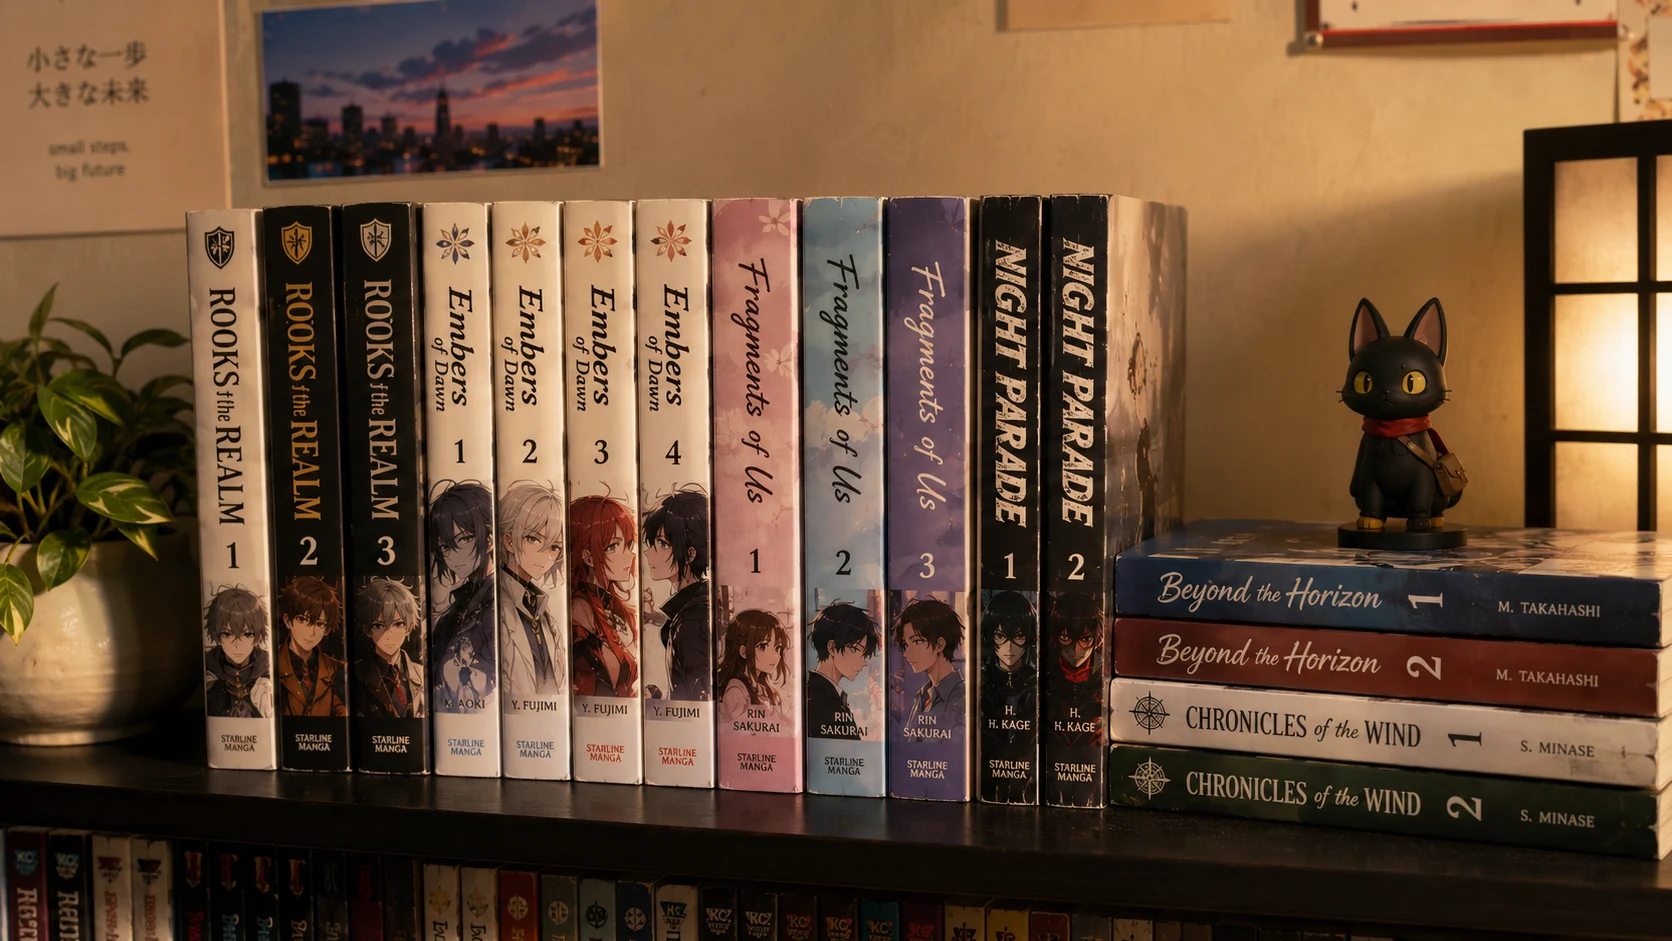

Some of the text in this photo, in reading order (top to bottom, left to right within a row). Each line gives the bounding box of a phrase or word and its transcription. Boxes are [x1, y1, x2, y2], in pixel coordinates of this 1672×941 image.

[26, 40, 148, 73] 小さな一歩
[28, 77, 150, 109] 大きな未来
[48, 140, 86, 156] small
[55, 162, 126, 182] big future
[285, 281, 317, 381] ROOKS
[363, 279, 395, 379] ROOKS
[209, 287, 240, 388] ROOKS
[518, 285, 545, 406] Embers
[591, 284, 616, 406] Embers
[664, 284, 690, 406] Embers
[449, 286, 475, 407] Embers
[431, 337, 448, 412] of Dawn
[501, 336, 518, 412] of Dawn
[573, 336, 590, 412] of Dawn
[645, 335, 663, 412] of Dawn
[731, 258, 774, 504] Fragments of Us
[818, 254, 862, 503] Fragments of Us
[904, 261, 947, 510] Fragments of Us
[994, 239, 1027, 528] NIGHT PARADE
[1062, 237, 1095, 528] NIGHT PARADE
[454, 439, 466, 464] 1
[522, 439, 538, 464] 2
[594, 439, 609, 465] 3
[665, 440, 682, 466] 4
[215, 425, 245, 526] REALM
[291, 420, 321, 520] REALM
[368, 418, 399, 520] REALM
[226, 542, 240, 569] 1
[300, 536, 318, 565] 2
[377, 535, 396, 565] 3
[749, 548, 762, 575] 1
[835, 549, 852, 575] 2
[919, 552, 936, 580] 3
[1004, 553, 1017, 579] 1
[1067, 553, 1085, 580] 2
[1157, 571, 1601, 618] Beyond the Horizon 1 M. TAKAHASHI
[1156, 633, 1599, 688] Beyond the Horizon 2 M. TAKAHASHI
[458, 699, 485, 709] AOKI
[511, 700, 557, 712] Y. FUJIMI
[582, 703, 628, 716] Y. FUJIMI
[653, 706, 700, 718] Y. FUJIMI
[1005, 705, 1016, 716] H.
[747, 709, 766, 719] RIN
[834, 712, 854, 722] RIN
[918, 715, 937, 725] RIN
[1070, 708, 1081, 718] H.
[733, 721, 780, 733] SAKURAI
[820, 725, 868, 736] SAKURAI
[903, 727, 951, 739] SAKURAI
[988, 719, 1031, 731] H. KAGE
[1067, 722, 1095, 733] KAGE
[1185, 706, 1595, 758] CHRONICLES of the WIND 1 S. MINASE
[221, 734, 257, 744] STARLINE
[295, 733, 332, 744] STARLINE
[372, 735, 410, 745] STARLINE
[448, 738, 485, 748] STARLINE
[516, 740, 555, 750] STARLINE
[224, 743, 255, 752] MANGA
[298, 742, 331, 752] MANGA
[375, 744, 407, 753] MANGA
[450, 747, 482, 756] MANGA
[520, 749, 551, 759] MANGA
[586, 744, 625, 754] STARLINE
[658, 747, 697, 757] STARLINE
[590, 753, 622, 763] MANGA
[661, 757, 694, 766] MANGA
[737, 752, 776, 763] STARLINE
[824, 756, 864, 767] STARLINE
[907, 759, 948, 771] STARLINE
[989, 759, 1030, 771] STARLINE
[740, 762, 773, 772] MANGA
[827, 765, 861, 776] MANGA
[910, 769, 945, 779] MANGA
[992, 769, 1027, 779] MANGA
[1054, 762, 1096, 774] STARLINE
[1057, 772, 1093, 782] MANGA
[1185, 771, 1595, 828] CHRONICLES of the WIND 2 S. MINASE
